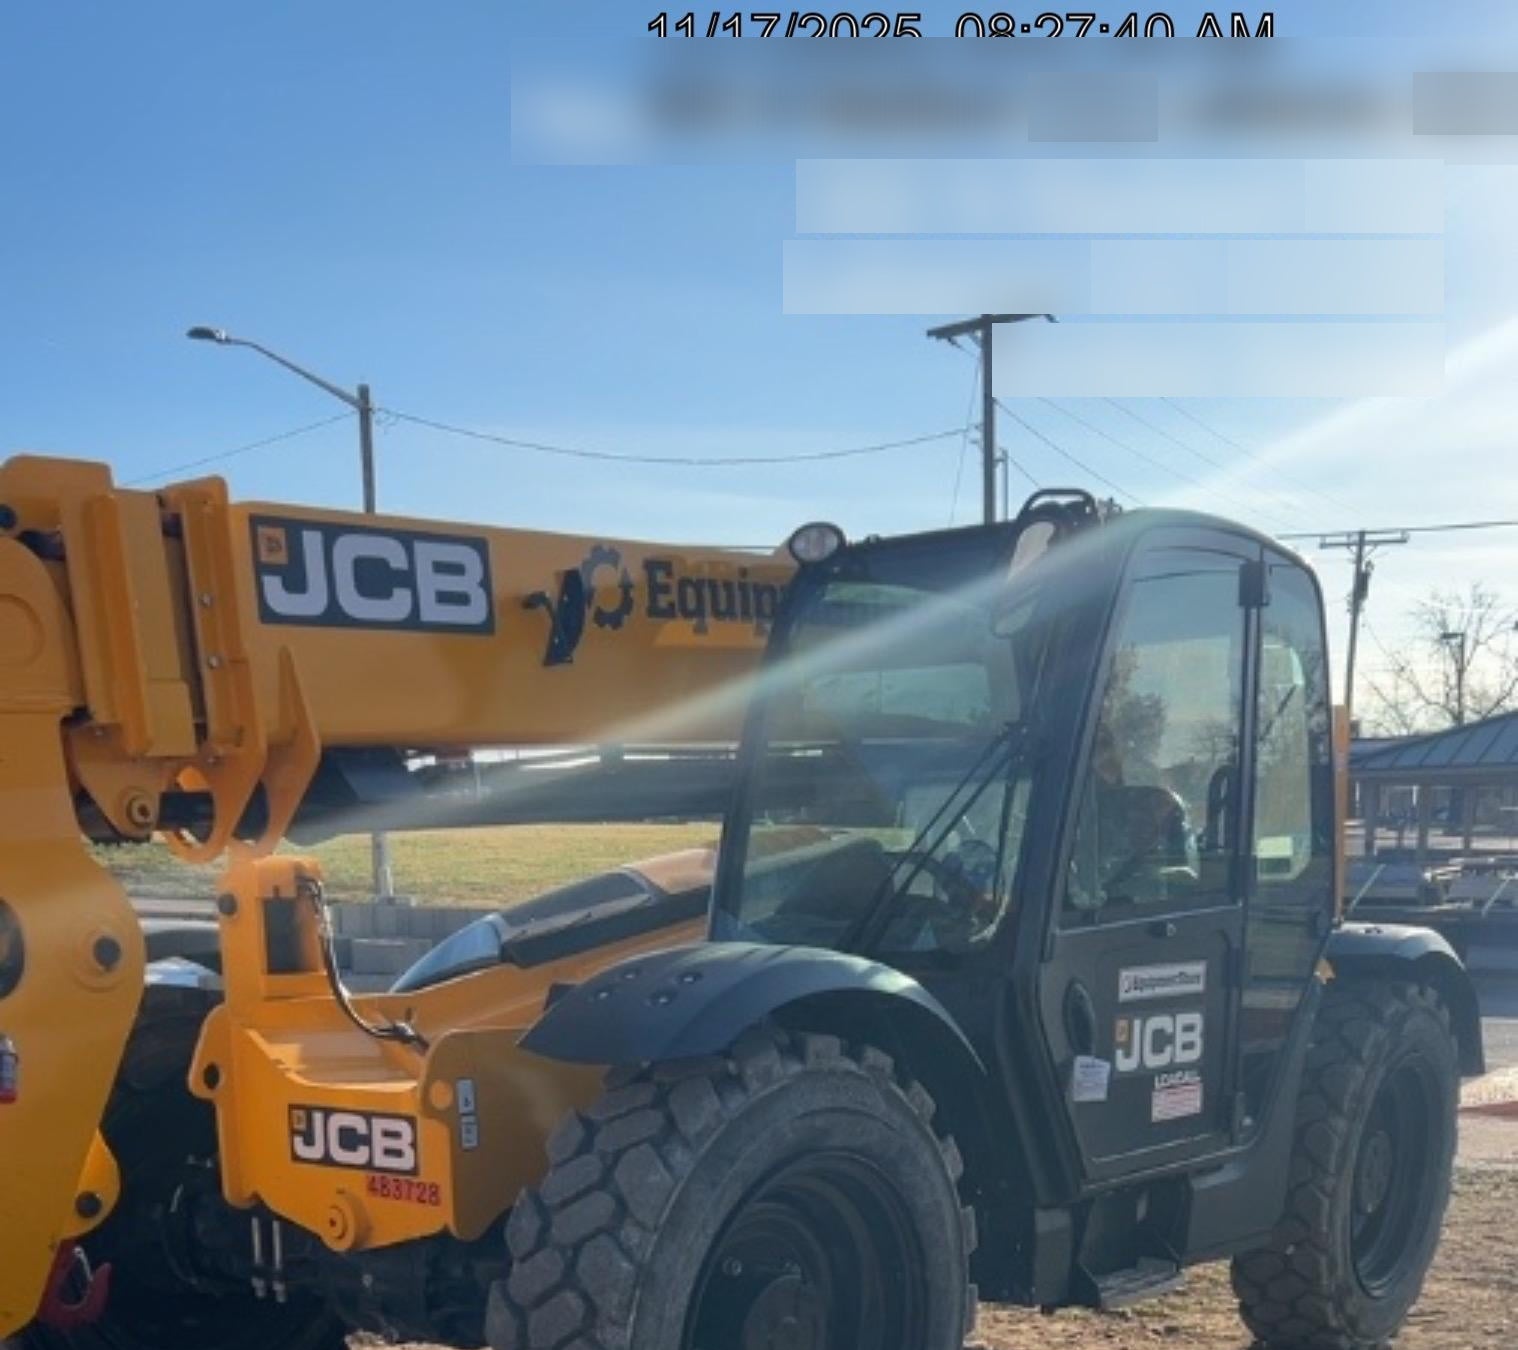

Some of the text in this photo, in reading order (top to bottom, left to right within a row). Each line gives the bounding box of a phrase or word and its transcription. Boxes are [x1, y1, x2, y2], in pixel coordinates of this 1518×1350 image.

[261, 529, 490, 626] JCB
[1115, 1012, 1203, 1072] JCB
[292, 1110, 416, 1171] JCB
